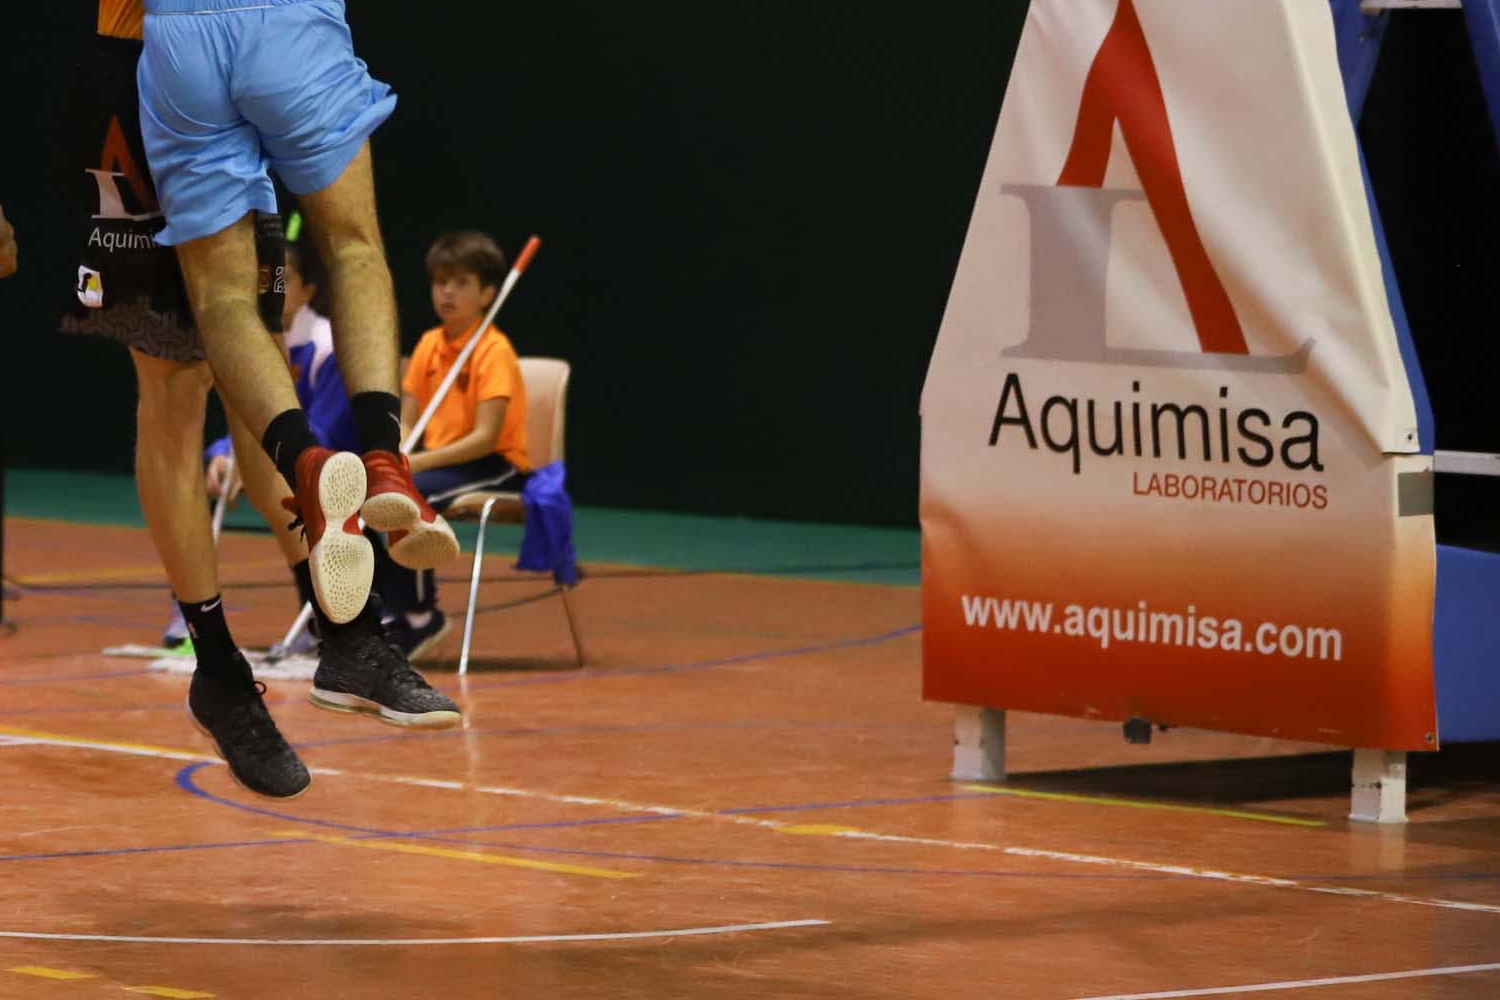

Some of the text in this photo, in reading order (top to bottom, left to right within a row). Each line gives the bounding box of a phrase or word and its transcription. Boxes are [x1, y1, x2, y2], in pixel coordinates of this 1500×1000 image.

[988, 372, 1326, 474] Aquimisa
[1132, 471, 1329, 510] LABORATORIOS
[961, 595, 1343, 661] www.aquimisa.com
